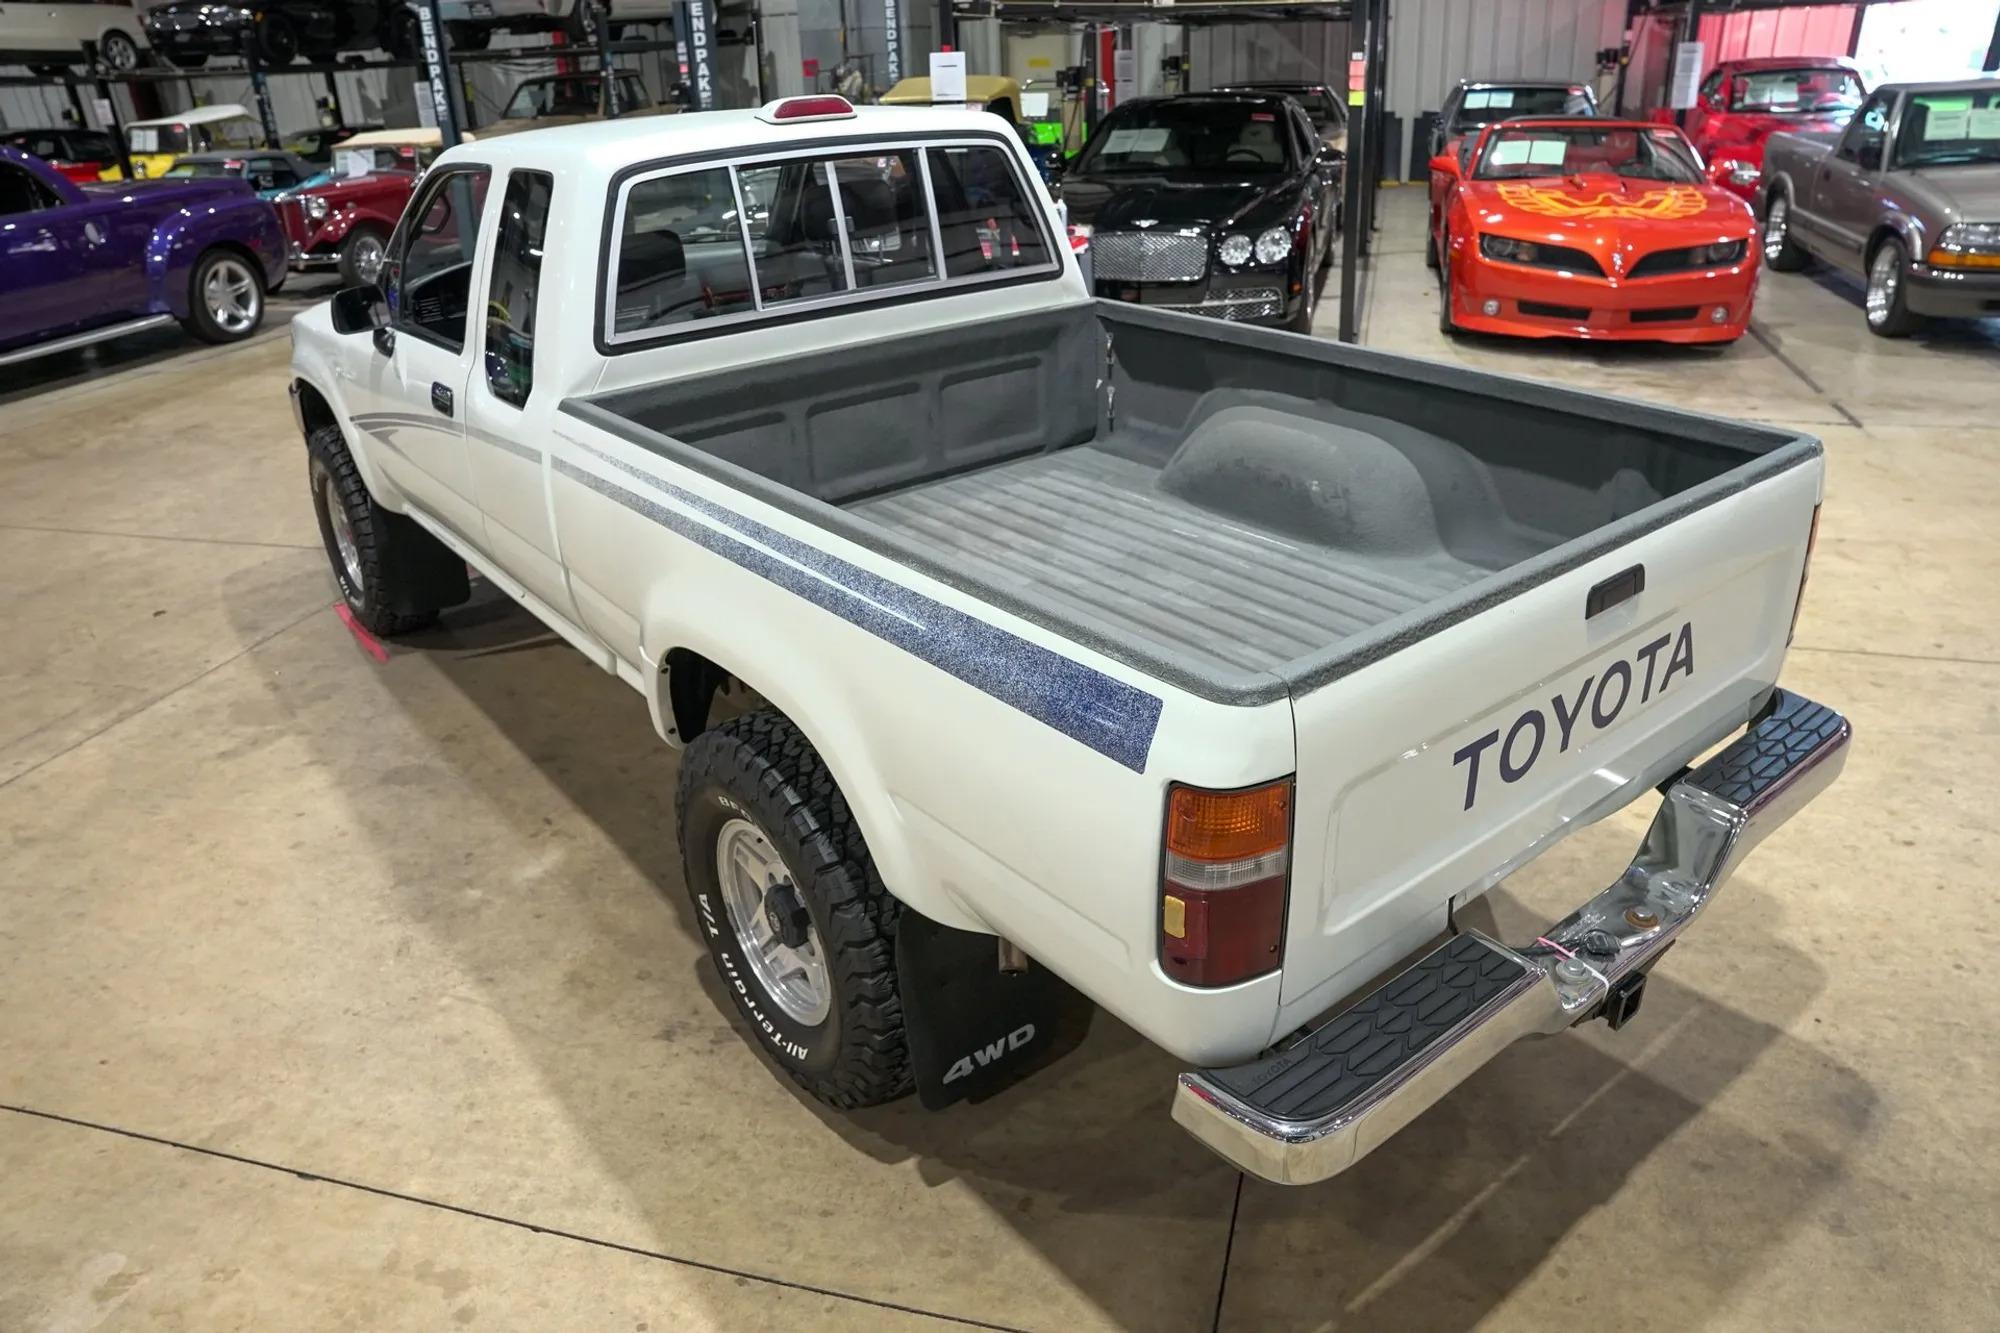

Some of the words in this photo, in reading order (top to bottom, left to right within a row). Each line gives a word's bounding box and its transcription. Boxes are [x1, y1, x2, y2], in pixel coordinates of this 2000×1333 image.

[419, 6, 446, 105] BENDPAK
[690, 0, 712, 91] ENDPAK
[1453, 622, 1694, 811] TOYOTA
[698, 894, 719, 937] T/A
[721, 953, 808, 1060] All-Terrain
[942, 1024, 1035, 1085] 4WD
